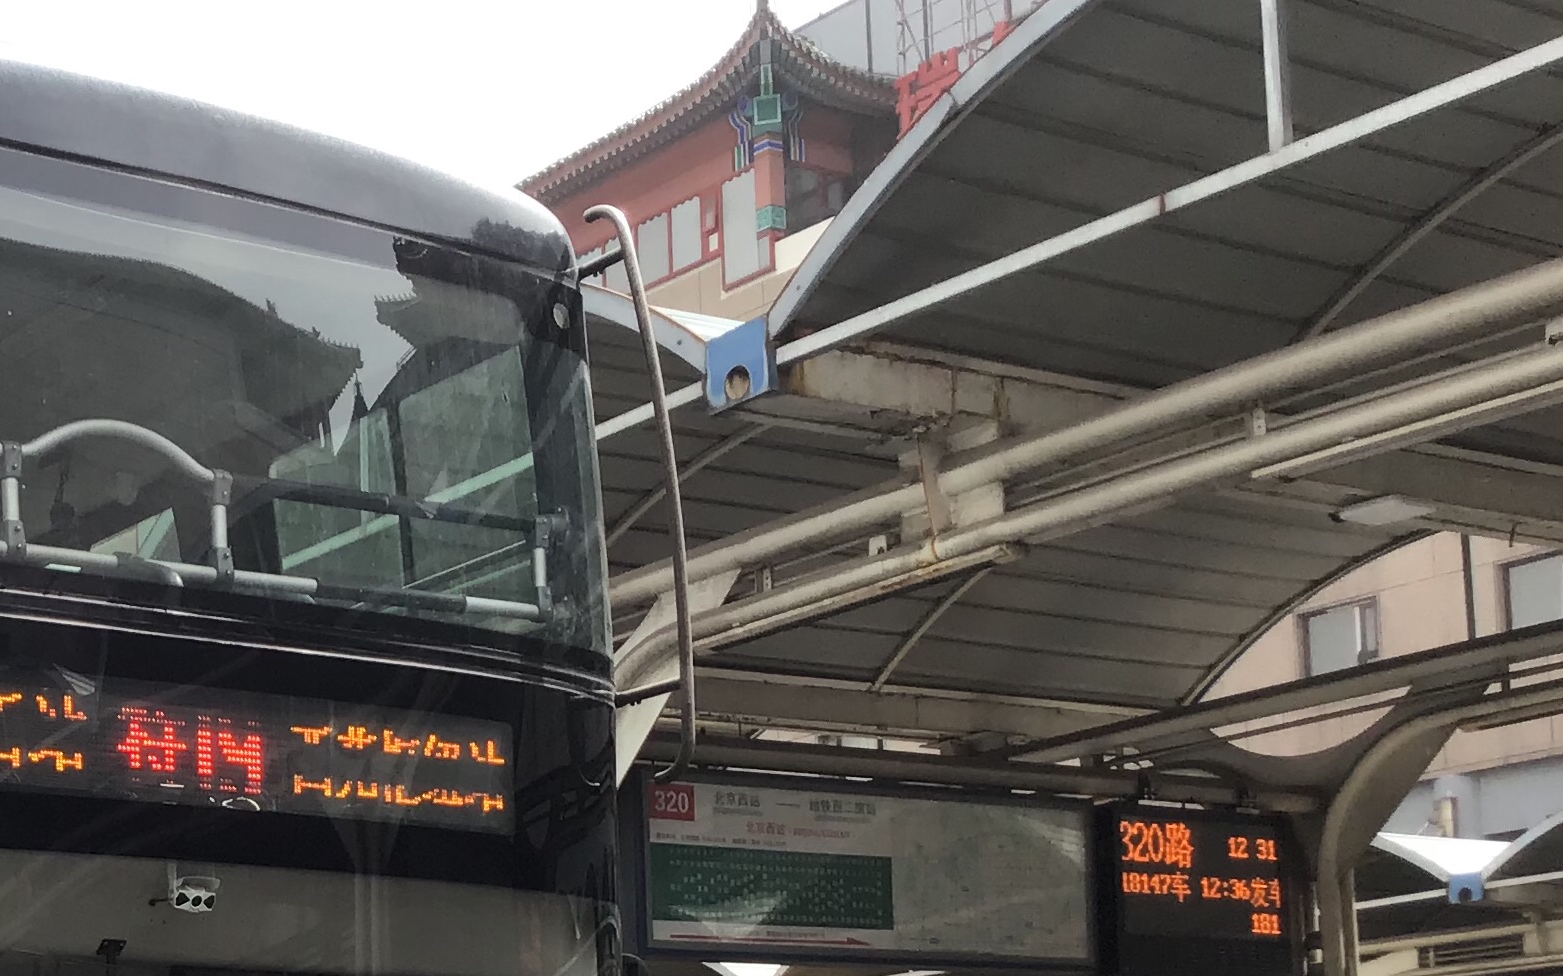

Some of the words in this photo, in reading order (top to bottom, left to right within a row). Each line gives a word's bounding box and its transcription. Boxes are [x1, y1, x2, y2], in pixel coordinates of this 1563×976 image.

[654, 790, 689, 814] 320
[1119, 821, 1195, 868] 320路
[1227, 836, 1250, 859] 12
[1255, 838, 1278, 861] 31
